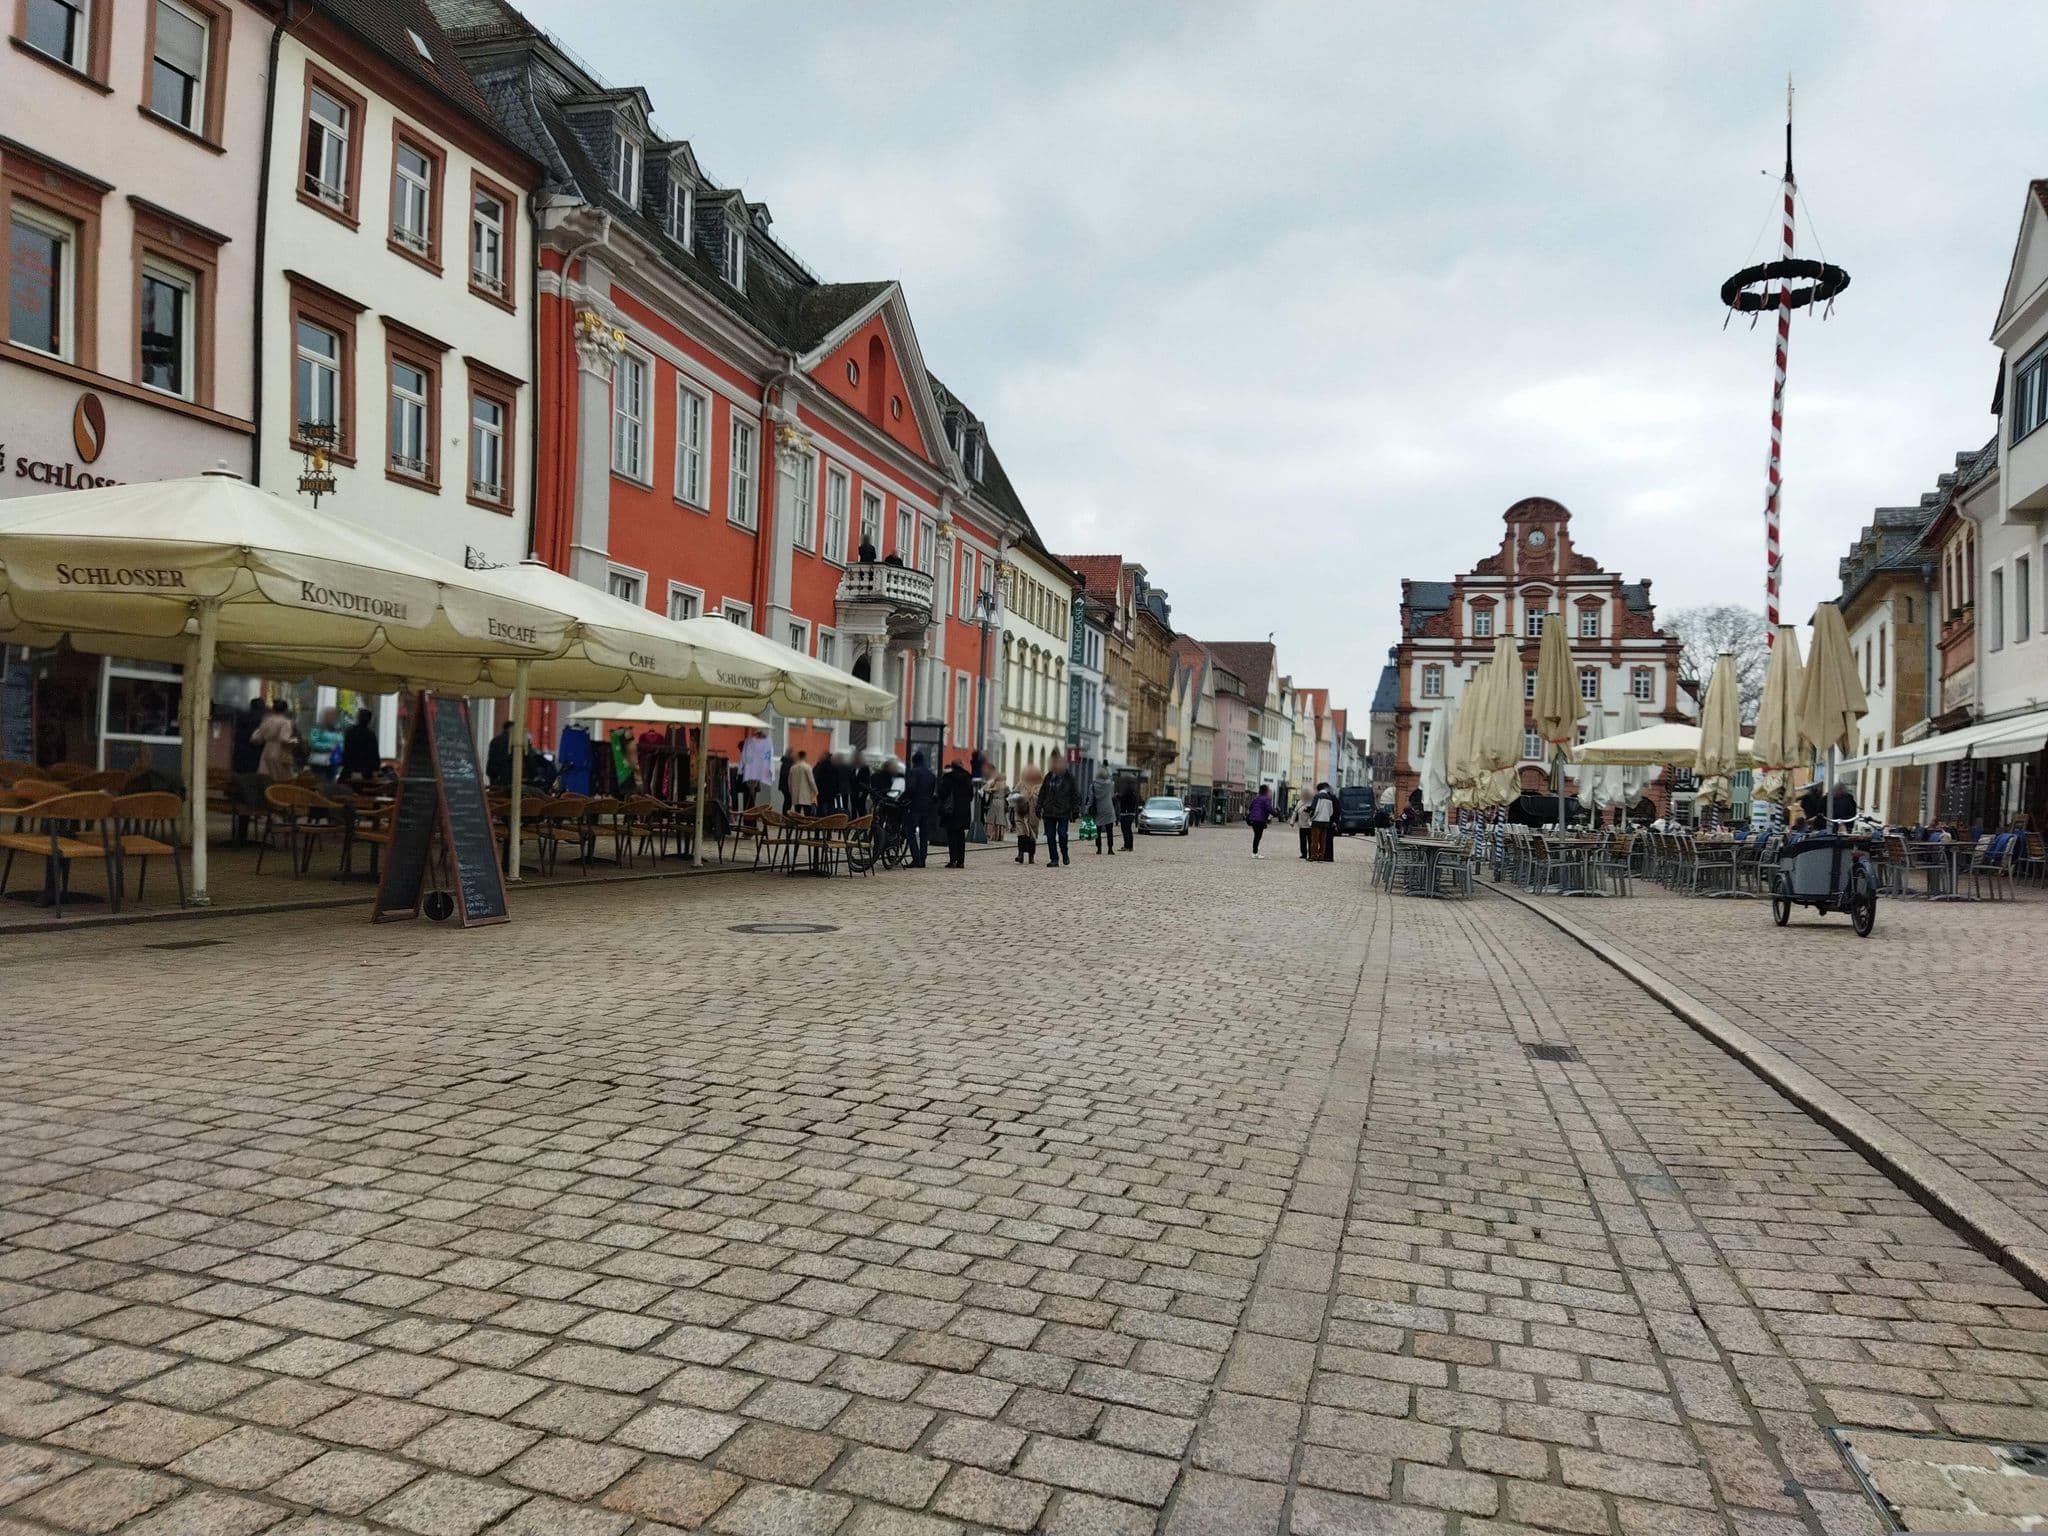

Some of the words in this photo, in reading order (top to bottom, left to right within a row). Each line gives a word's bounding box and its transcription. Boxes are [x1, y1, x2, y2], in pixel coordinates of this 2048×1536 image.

[303, 479, 332, 491] HOTEL
[56, 563, 187, 588] SCHLOSSER
[300, 580, 408, 620] KONDITOREI
[488, 617, 537, 644] EISCAFÉ
[629, 651, 656, 670] CAFÉ
